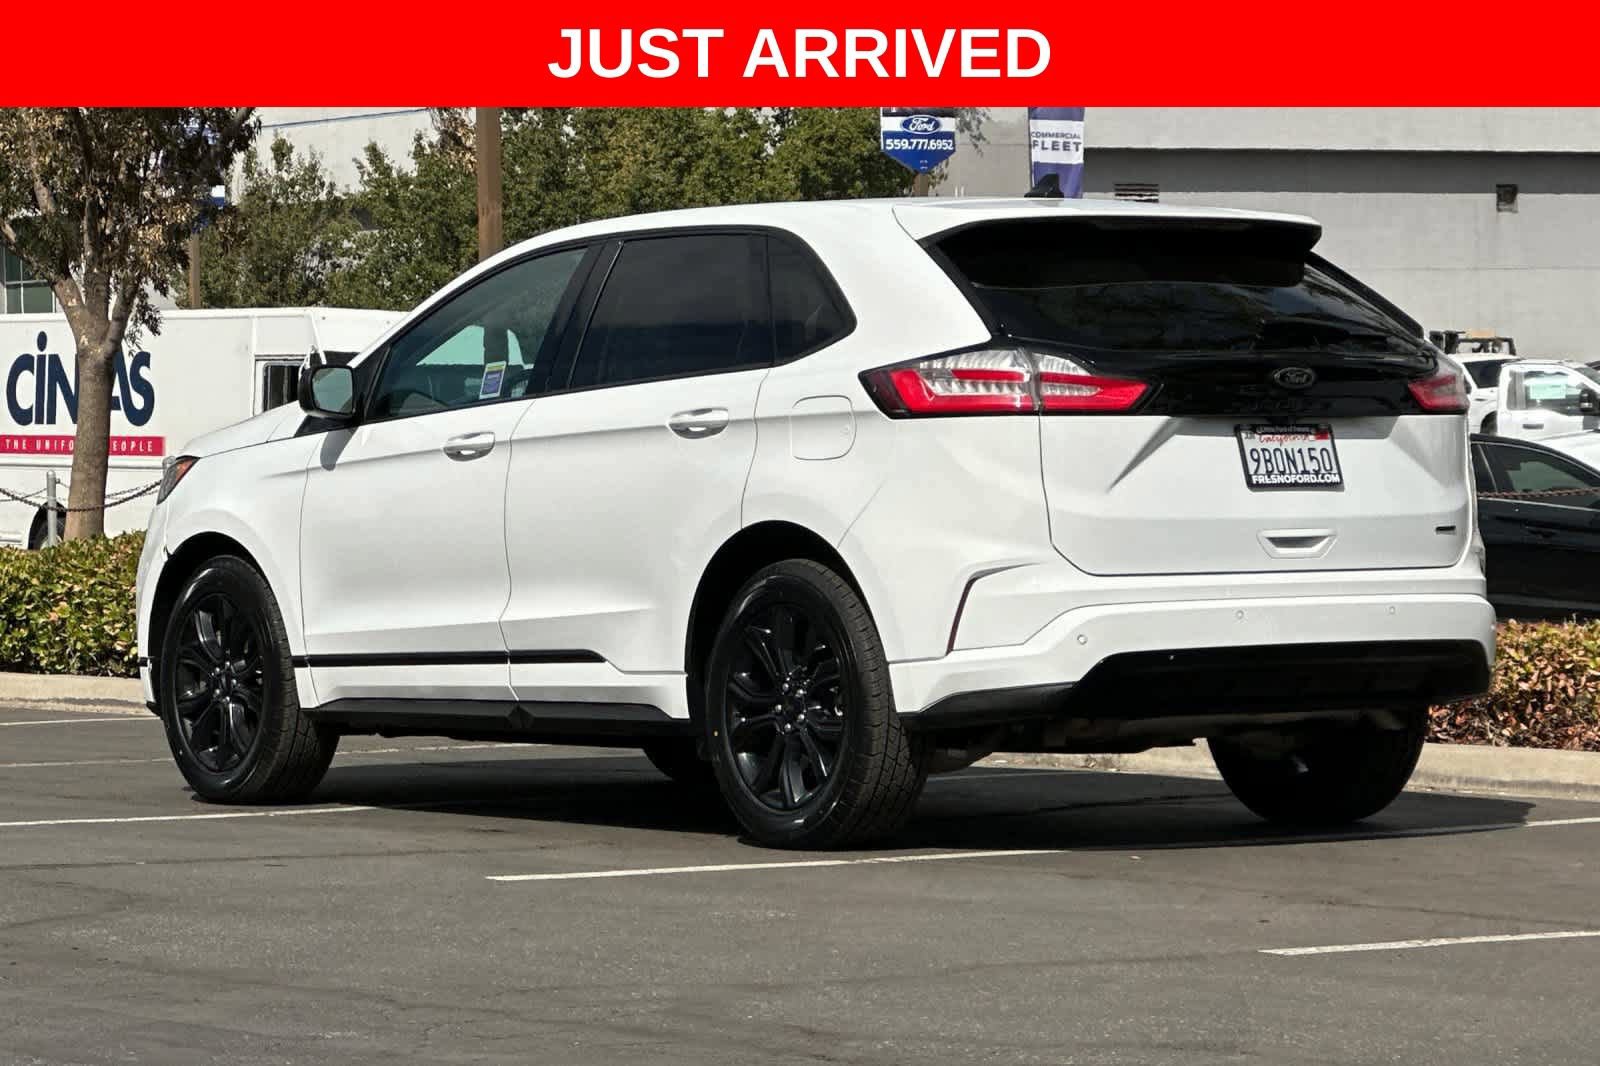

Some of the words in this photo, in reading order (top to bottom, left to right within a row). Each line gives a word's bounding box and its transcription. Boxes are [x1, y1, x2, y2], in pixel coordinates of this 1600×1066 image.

[909, 117, 936, 131] Ford
[1030, 131, 1082, 140] COMMERCIAL
[885, 138, 955, 151] 559.777.6952
[1032, 140, 1083, 152] FLEET
[5, 438, 27, 450] THE
[36, 439, 76, 451] UNIFO
[112, 441, 153, 453] EOPLE
[1252, 474, 1341, 484] FRESNOFORD.COM
